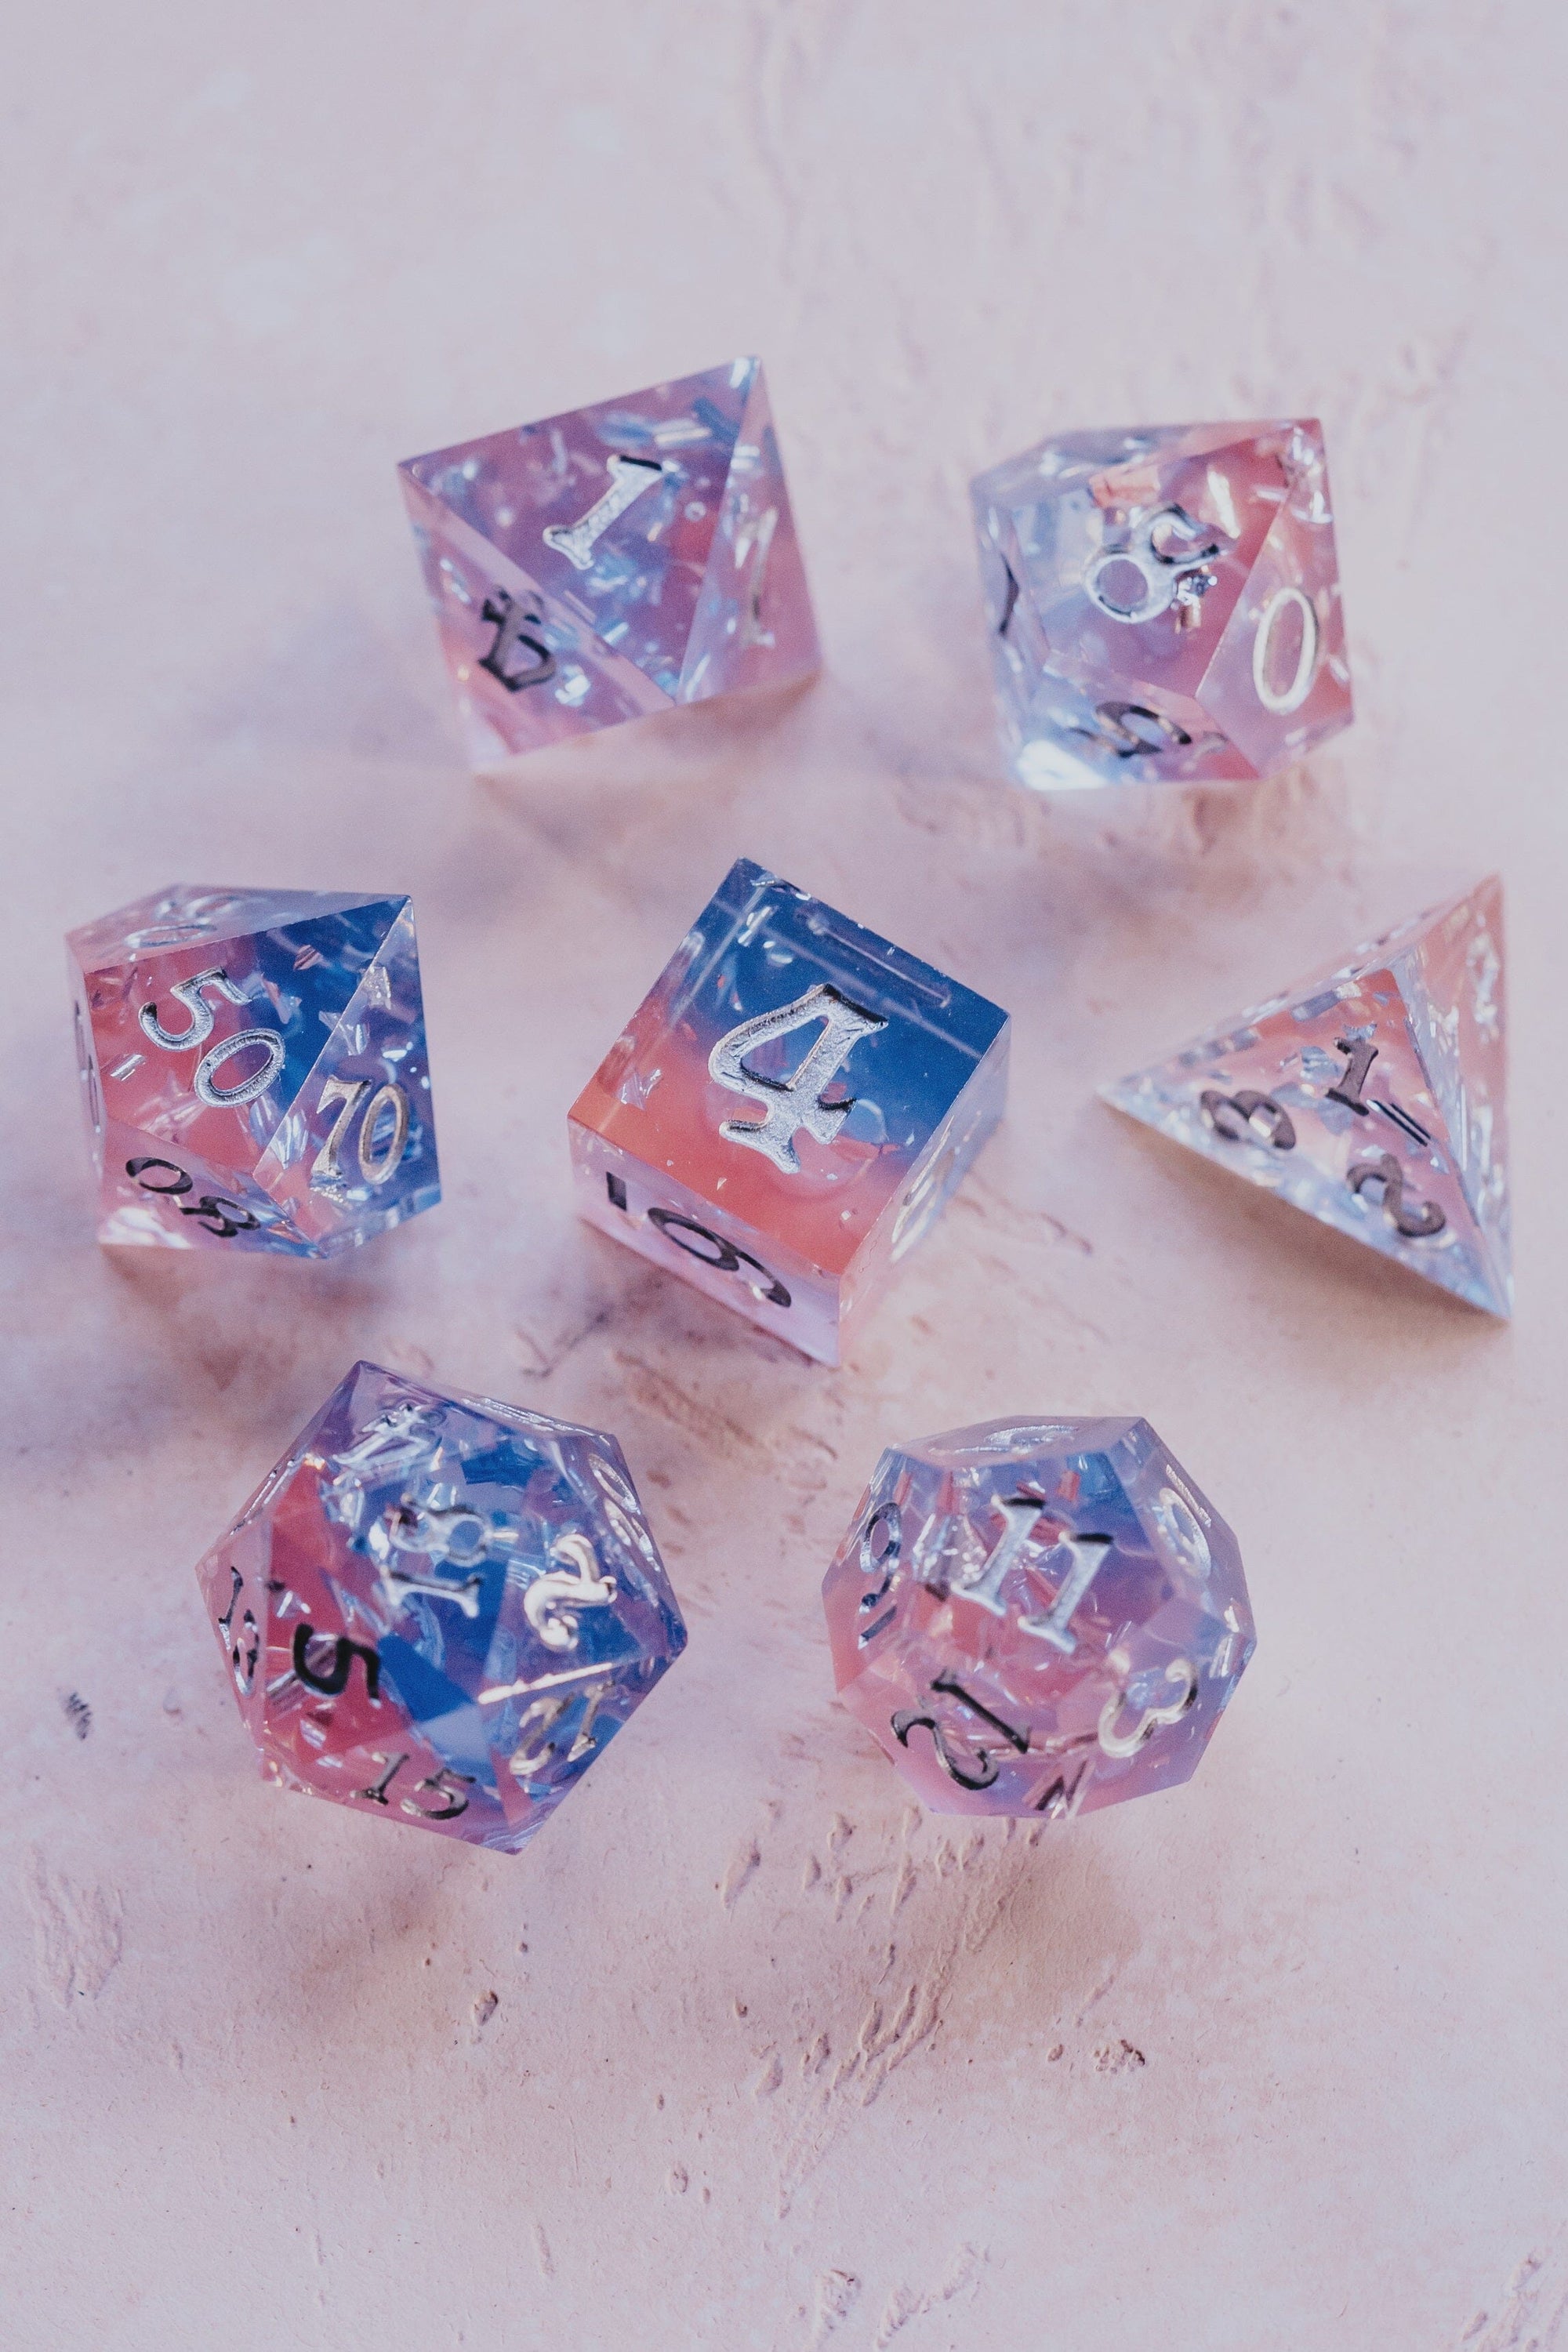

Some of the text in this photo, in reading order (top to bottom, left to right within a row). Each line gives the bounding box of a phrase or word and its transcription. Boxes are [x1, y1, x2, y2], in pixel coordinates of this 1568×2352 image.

[543, 455, 663, 570] 1
[1254, 586, 1321, 717] 0
[138, 967, 285, 1108] 50
[708, 983, 889, 1174] 4
[1324, 1035, 1379, 1117] 1
[310, 1075, 409, 1185] 70
[1199, 1089, 1297, 1151] 3
[1346, 1153, 1446, 1238] 2
[524, 1534, 619, 1651] 2
[951, 1494, 1114, 1654] 11
[292, 1623, 383, 1708] 5
[1098, 1650, 1200, 1759] 3
[350, 1751, 477, 1821] 15
[890, 1670, 1031, 1791] 12
